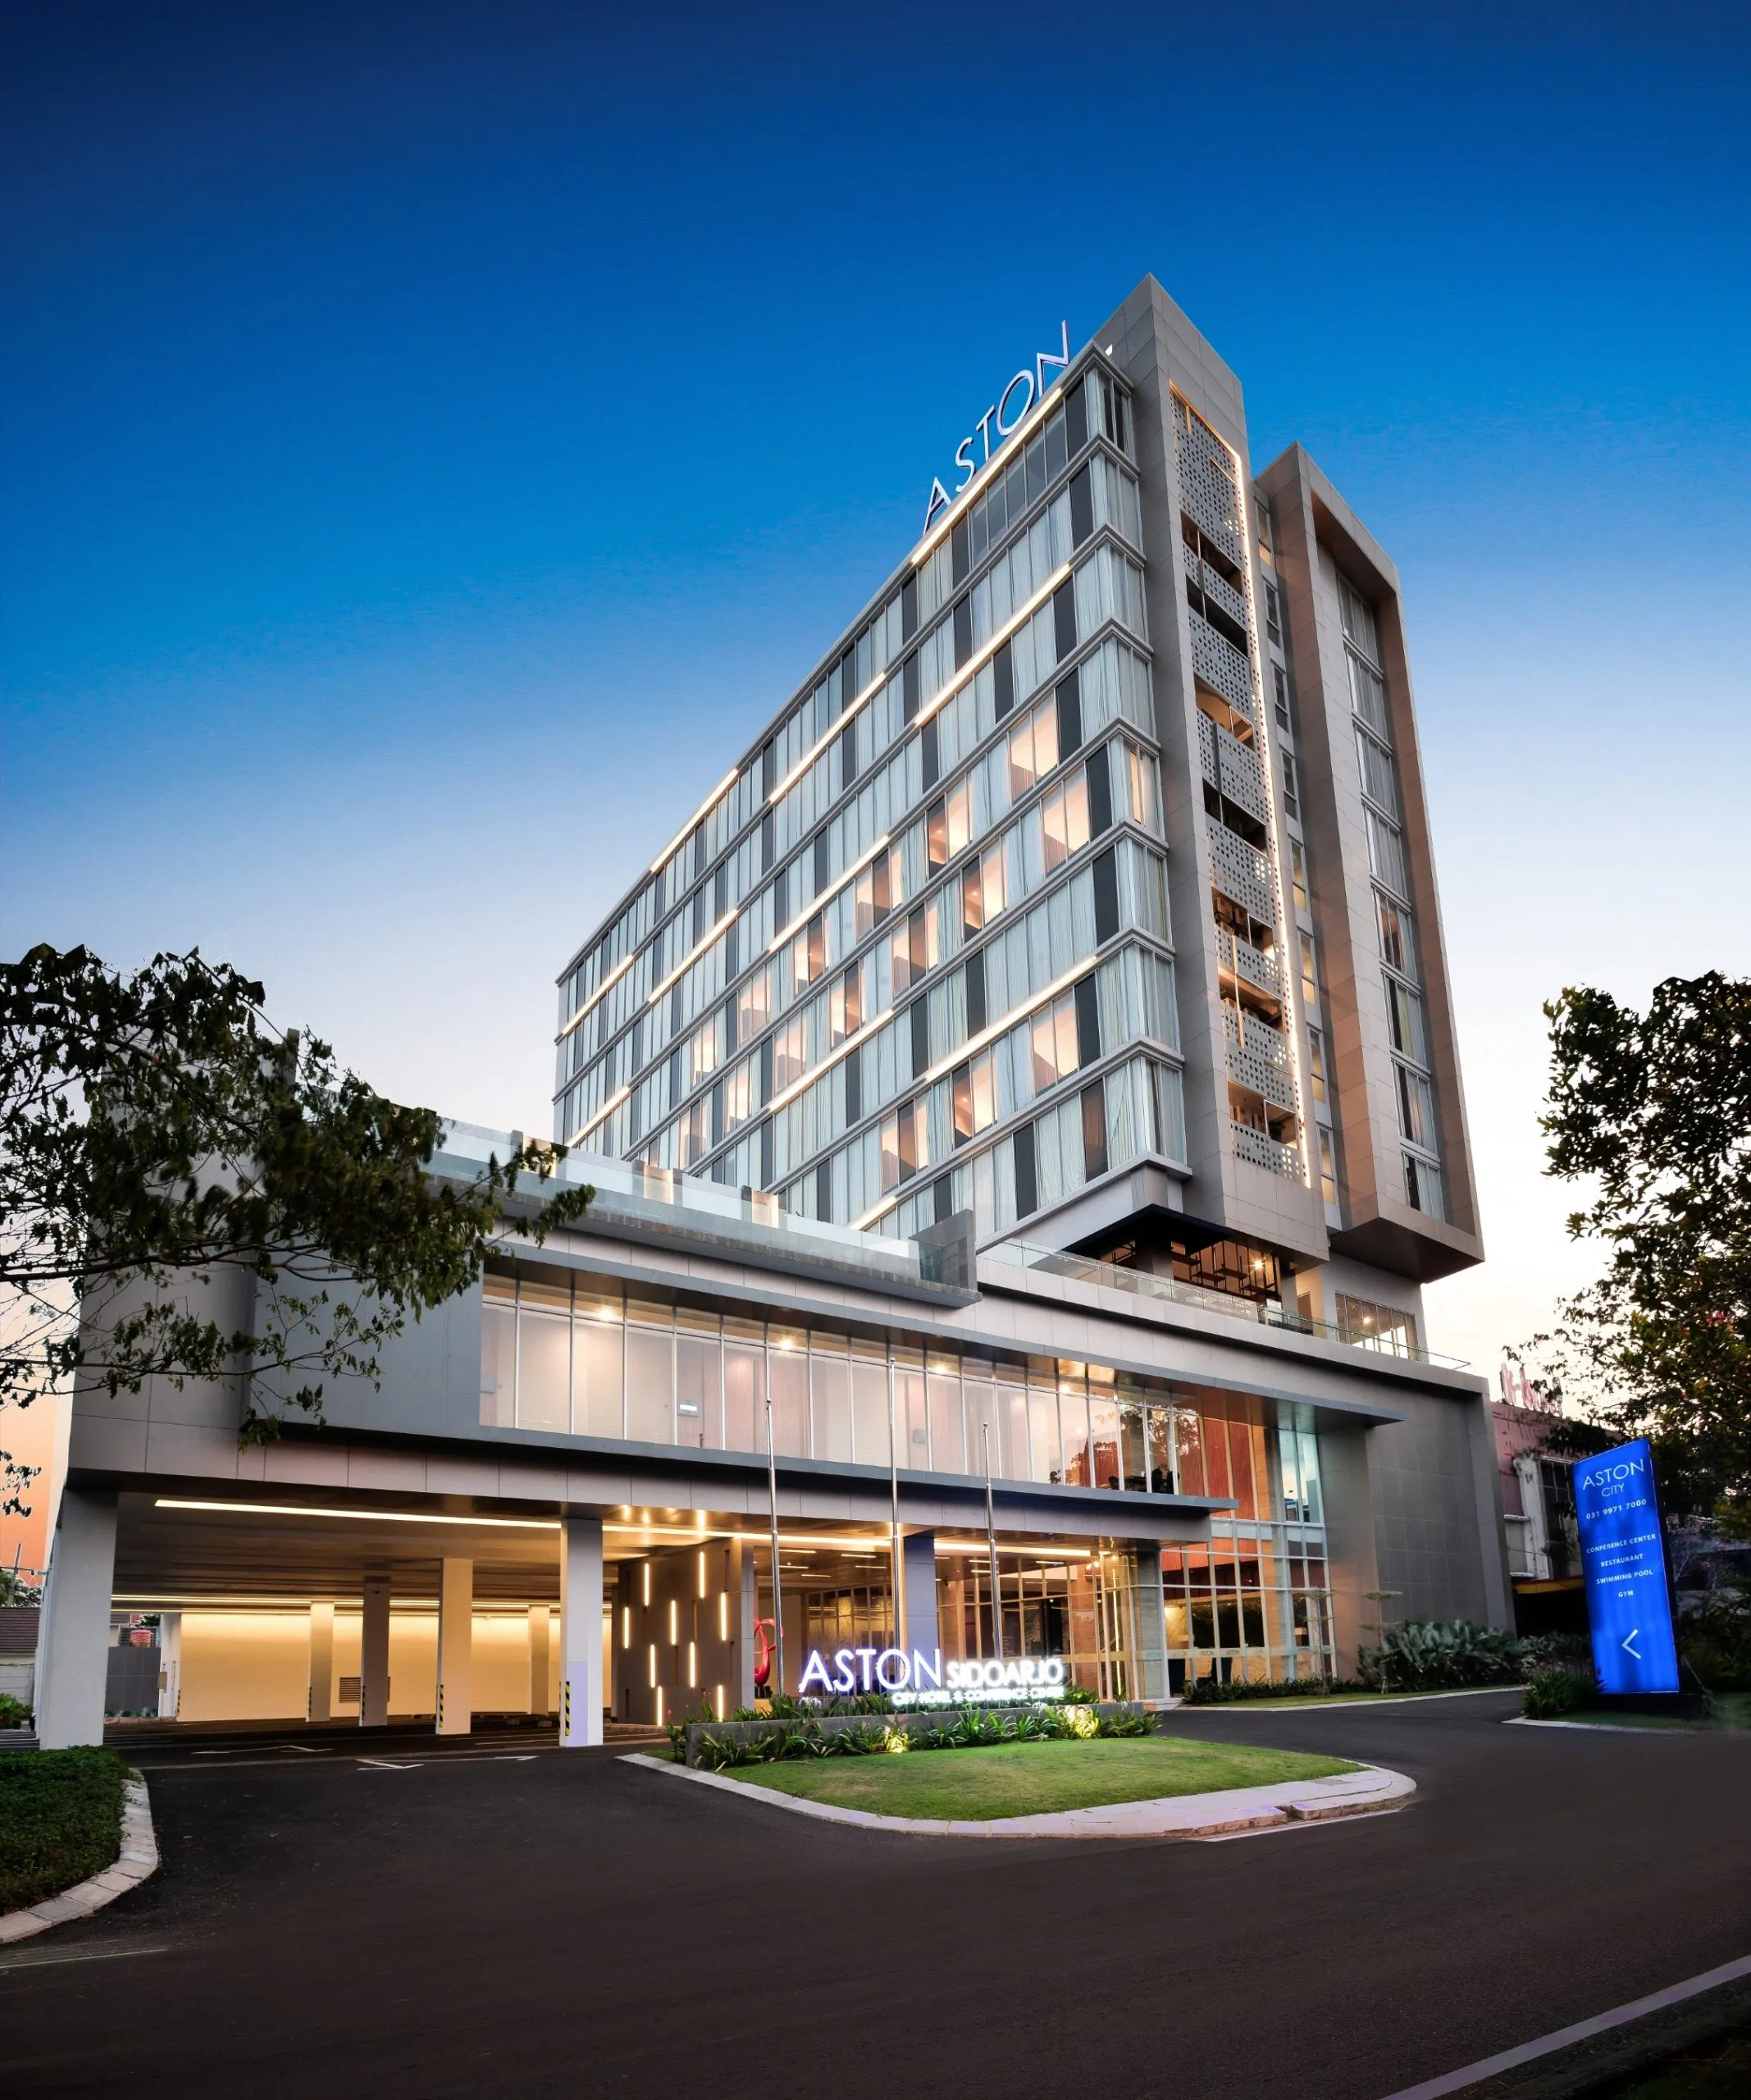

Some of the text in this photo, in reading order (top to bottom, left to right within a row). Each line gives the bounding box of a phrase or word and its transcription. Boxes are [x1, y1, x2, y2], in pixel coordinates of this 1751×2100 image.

[923, 320, 1069, 535] ASTON
[1583, 1459, 1644, 1490] ASTON
[1601, 1483, 1624, 1497] CITY
[1586, 1499, 1647, 1519] 031 9971 7000
[1586, 1533, 1656, 1554] CONFERENCE CENTER
[1600, 1554, 1644, 1568] RESTAURANT
[1596, 1569, 1653, 1585] SWIMMING POOL
[799, 1649, 1063, 1693] ASTON SIDOARJO
